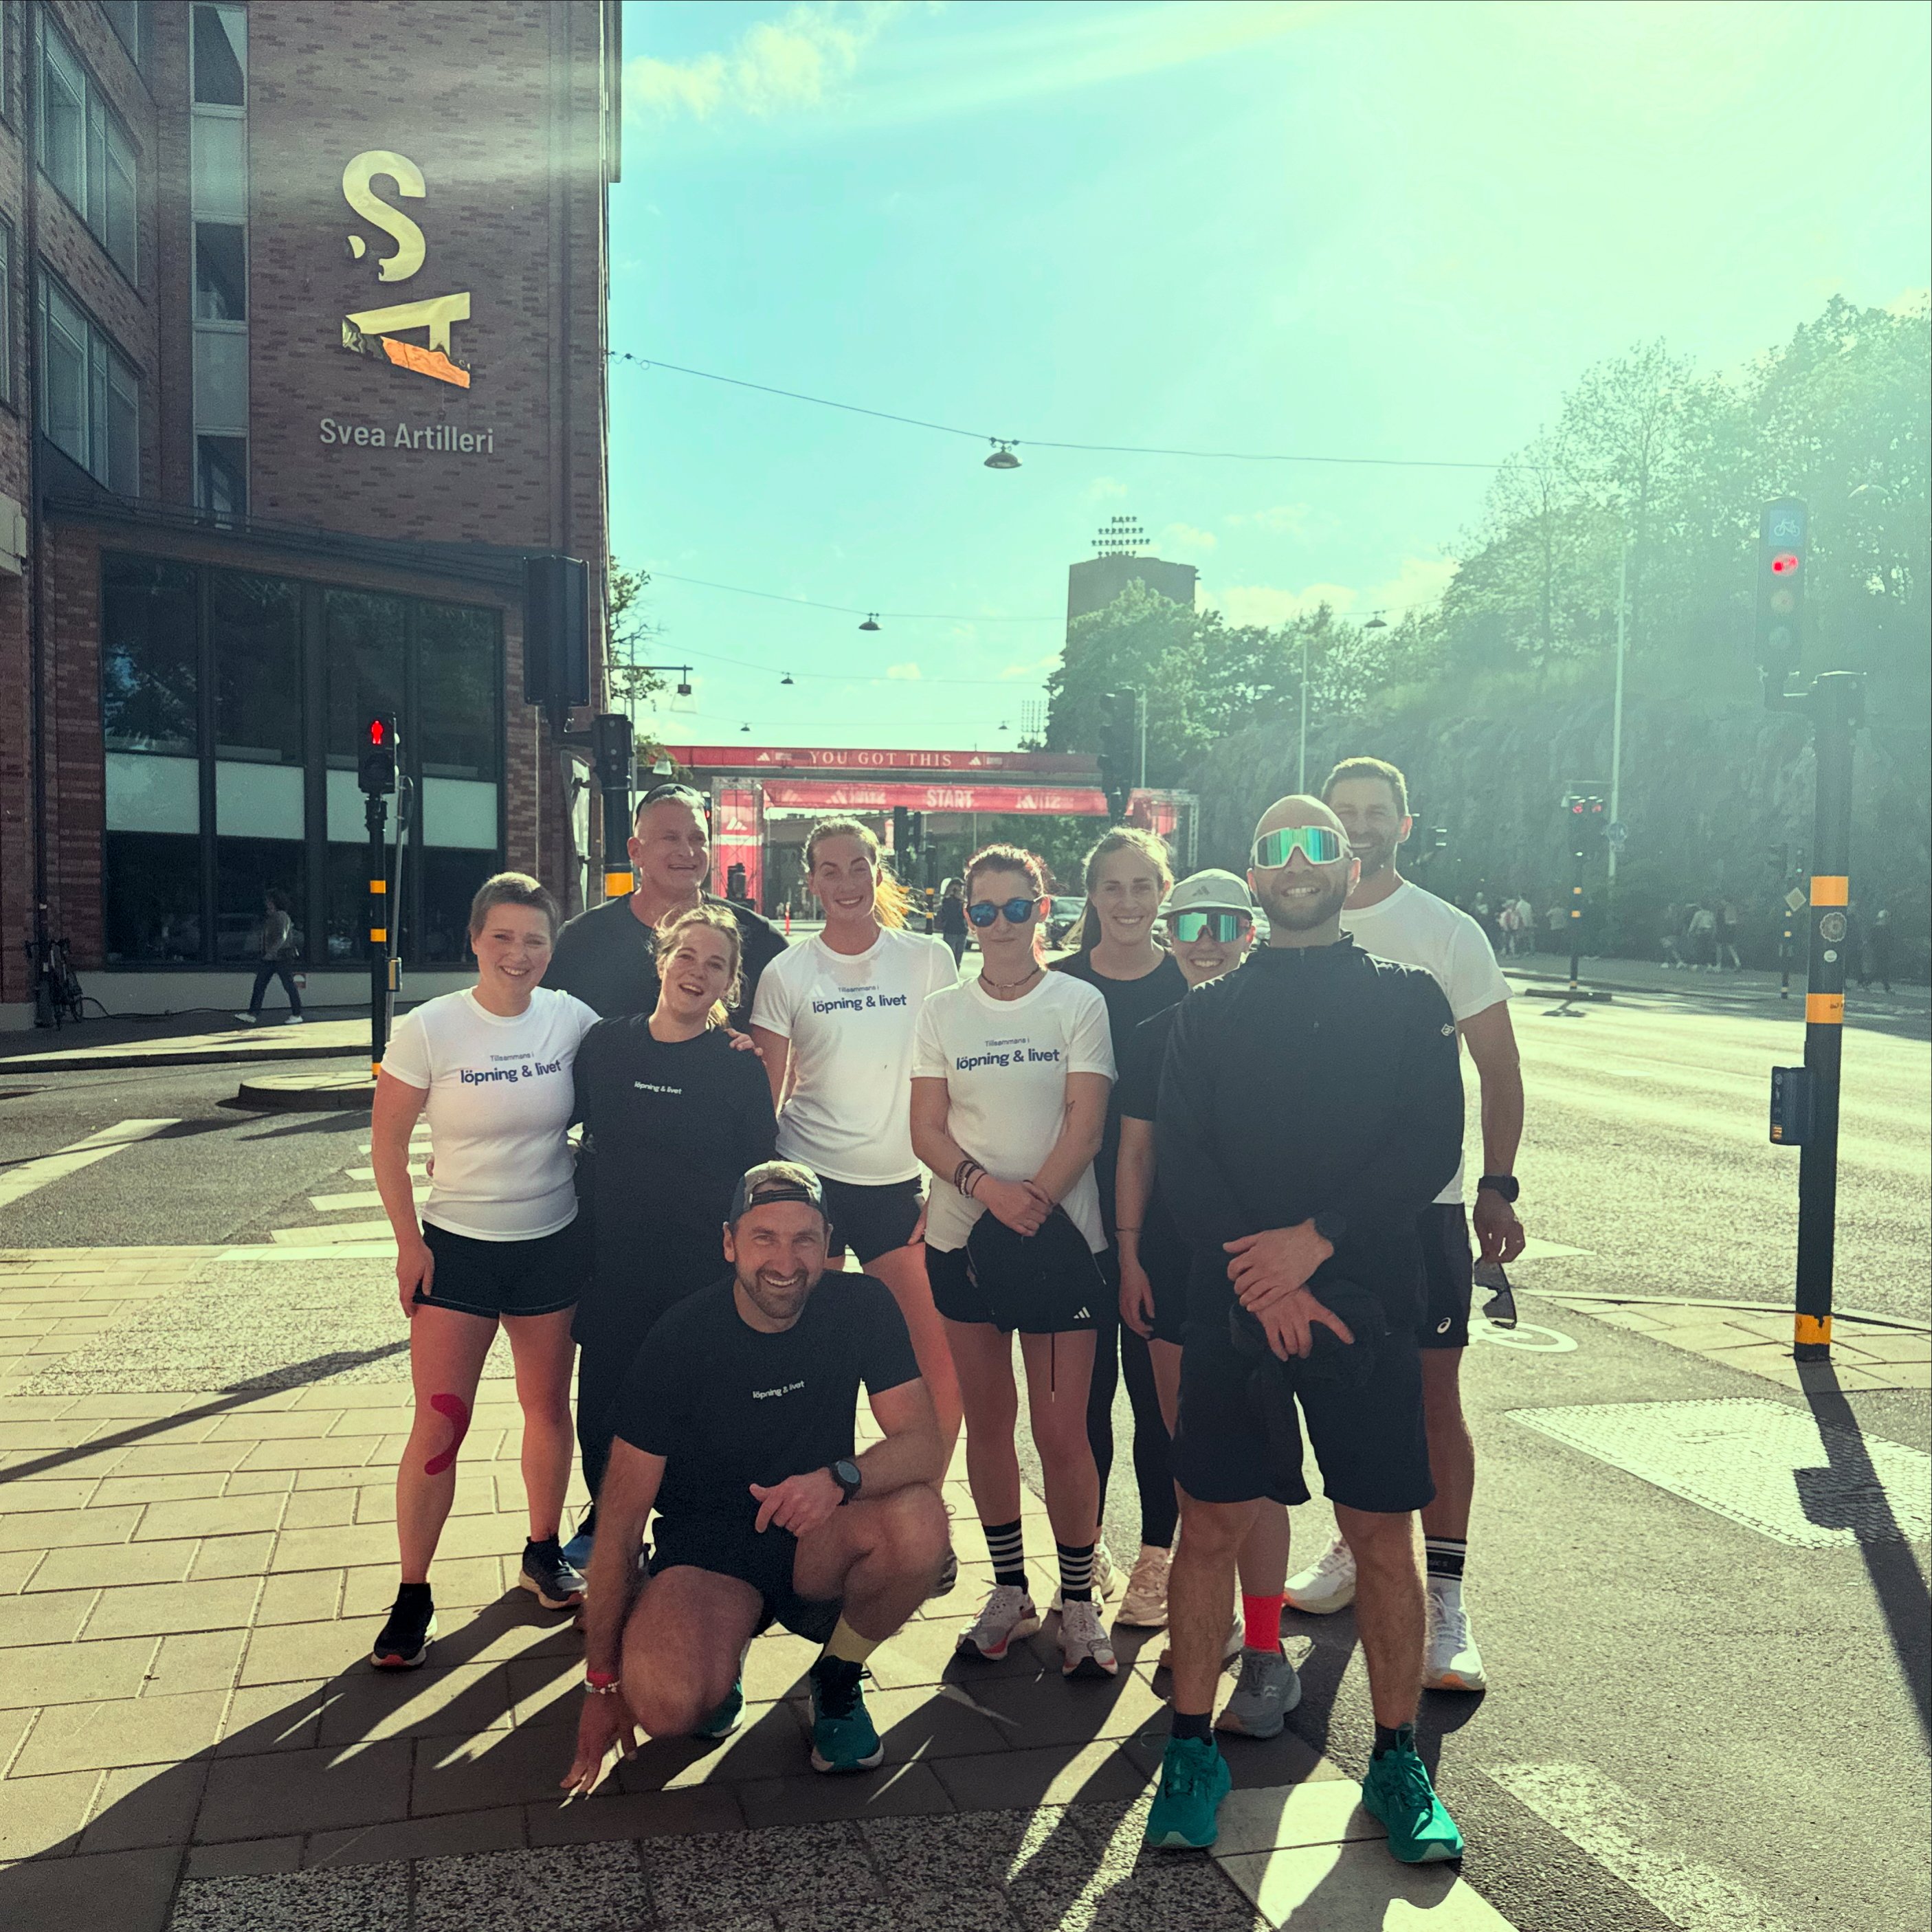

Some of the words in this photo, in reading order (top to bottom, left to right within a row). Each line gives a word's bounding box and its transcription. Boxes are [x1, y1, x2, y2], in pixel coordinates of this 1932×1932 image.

[320, 418, 386, 447] Svea
[394, 423, 493, 454] Artilleri
[810, 751, 847, 765] YOU
[858, 752, 897, 766] GOT
[907, 753, 951, 766] THIS
[926, 788, 975, 808] START
[812, 997, 863, 1014] löpning
[866, 995, 876, 1008] &
[879, 994, 907, 1006] livet
[956, 1052, 1010, 1071] löpning
[1013, 1050, 1024, 1063] &
[1028, 1048, 1060, 1062] livet
[460, 1067, 518, 1085] löpning
[522, 1065, 533, 1078] &
[535, 1059, 562, 1076] livet
[634, 1080, 660, 1093] löpning
[753, 1388, 782, 1400] löpning
[789, 1380, 804, 1390] livet
